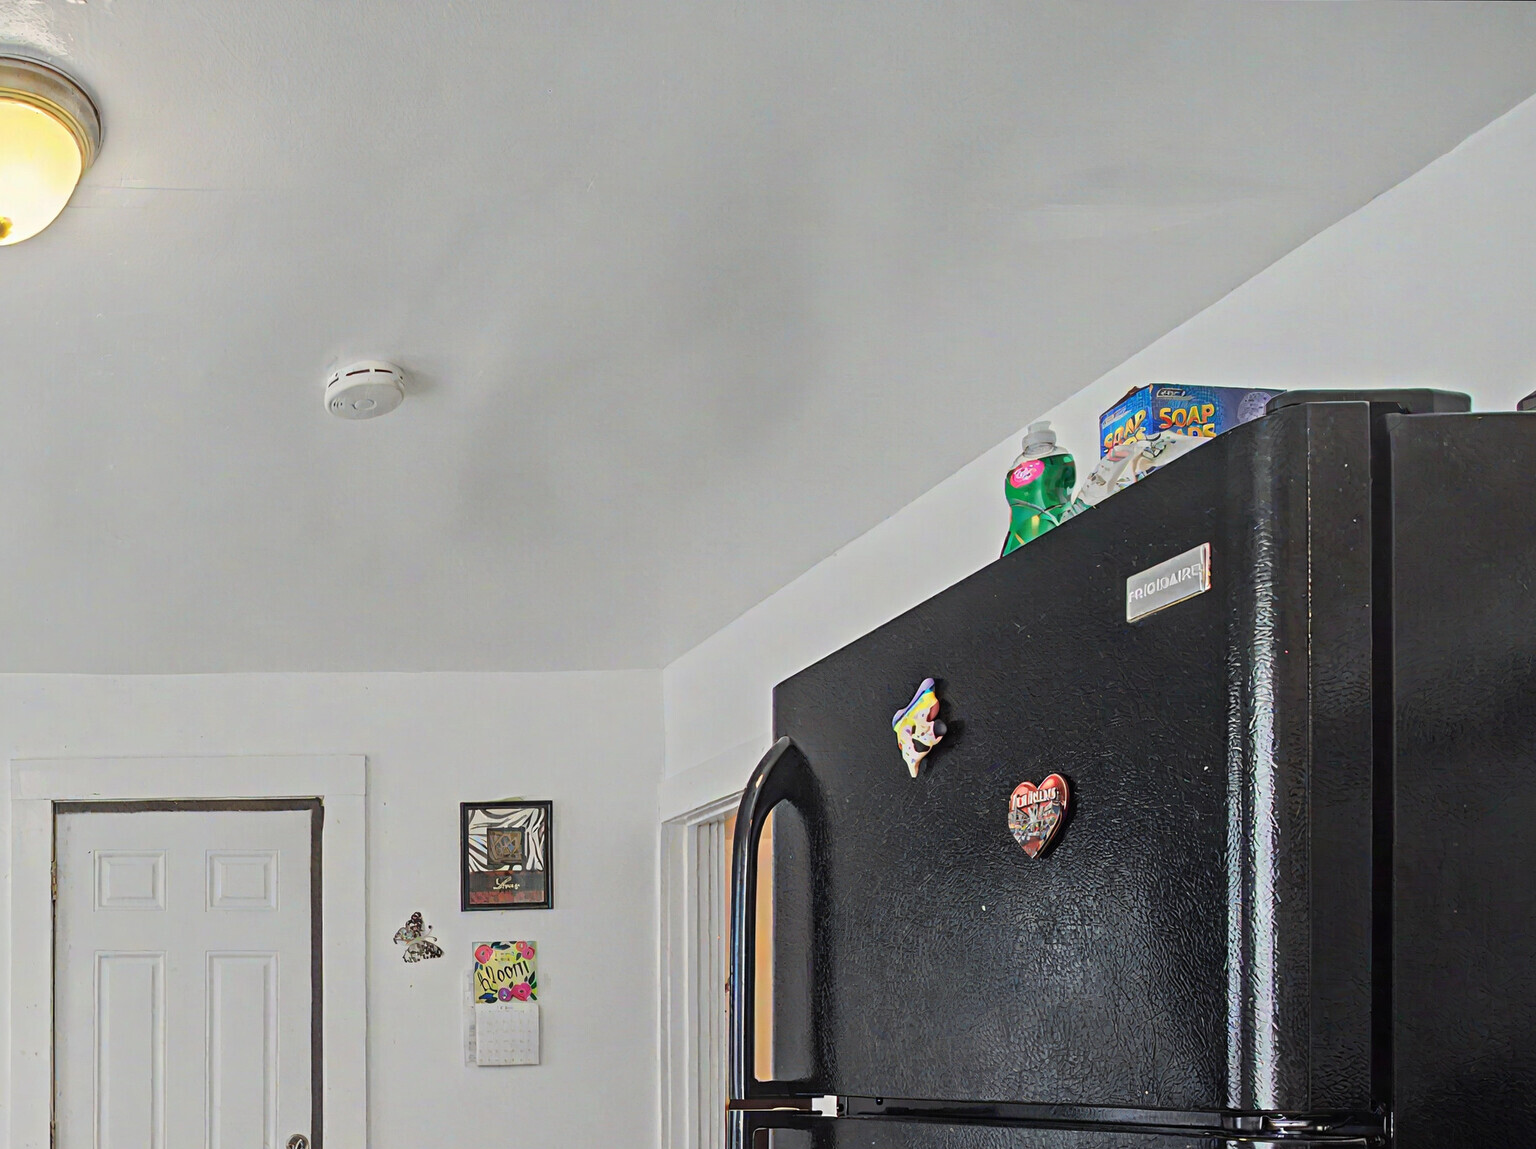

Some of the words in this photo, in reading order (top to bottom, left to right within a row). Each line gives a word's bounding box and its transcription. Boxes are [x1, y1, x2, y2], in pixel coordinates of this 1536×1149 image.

[1104, 409, 1147, 452] SOAP
[1159, 403, 1215, 429] SOAP
[1129, 562, 1203, 603] FRIGIDAIRE
